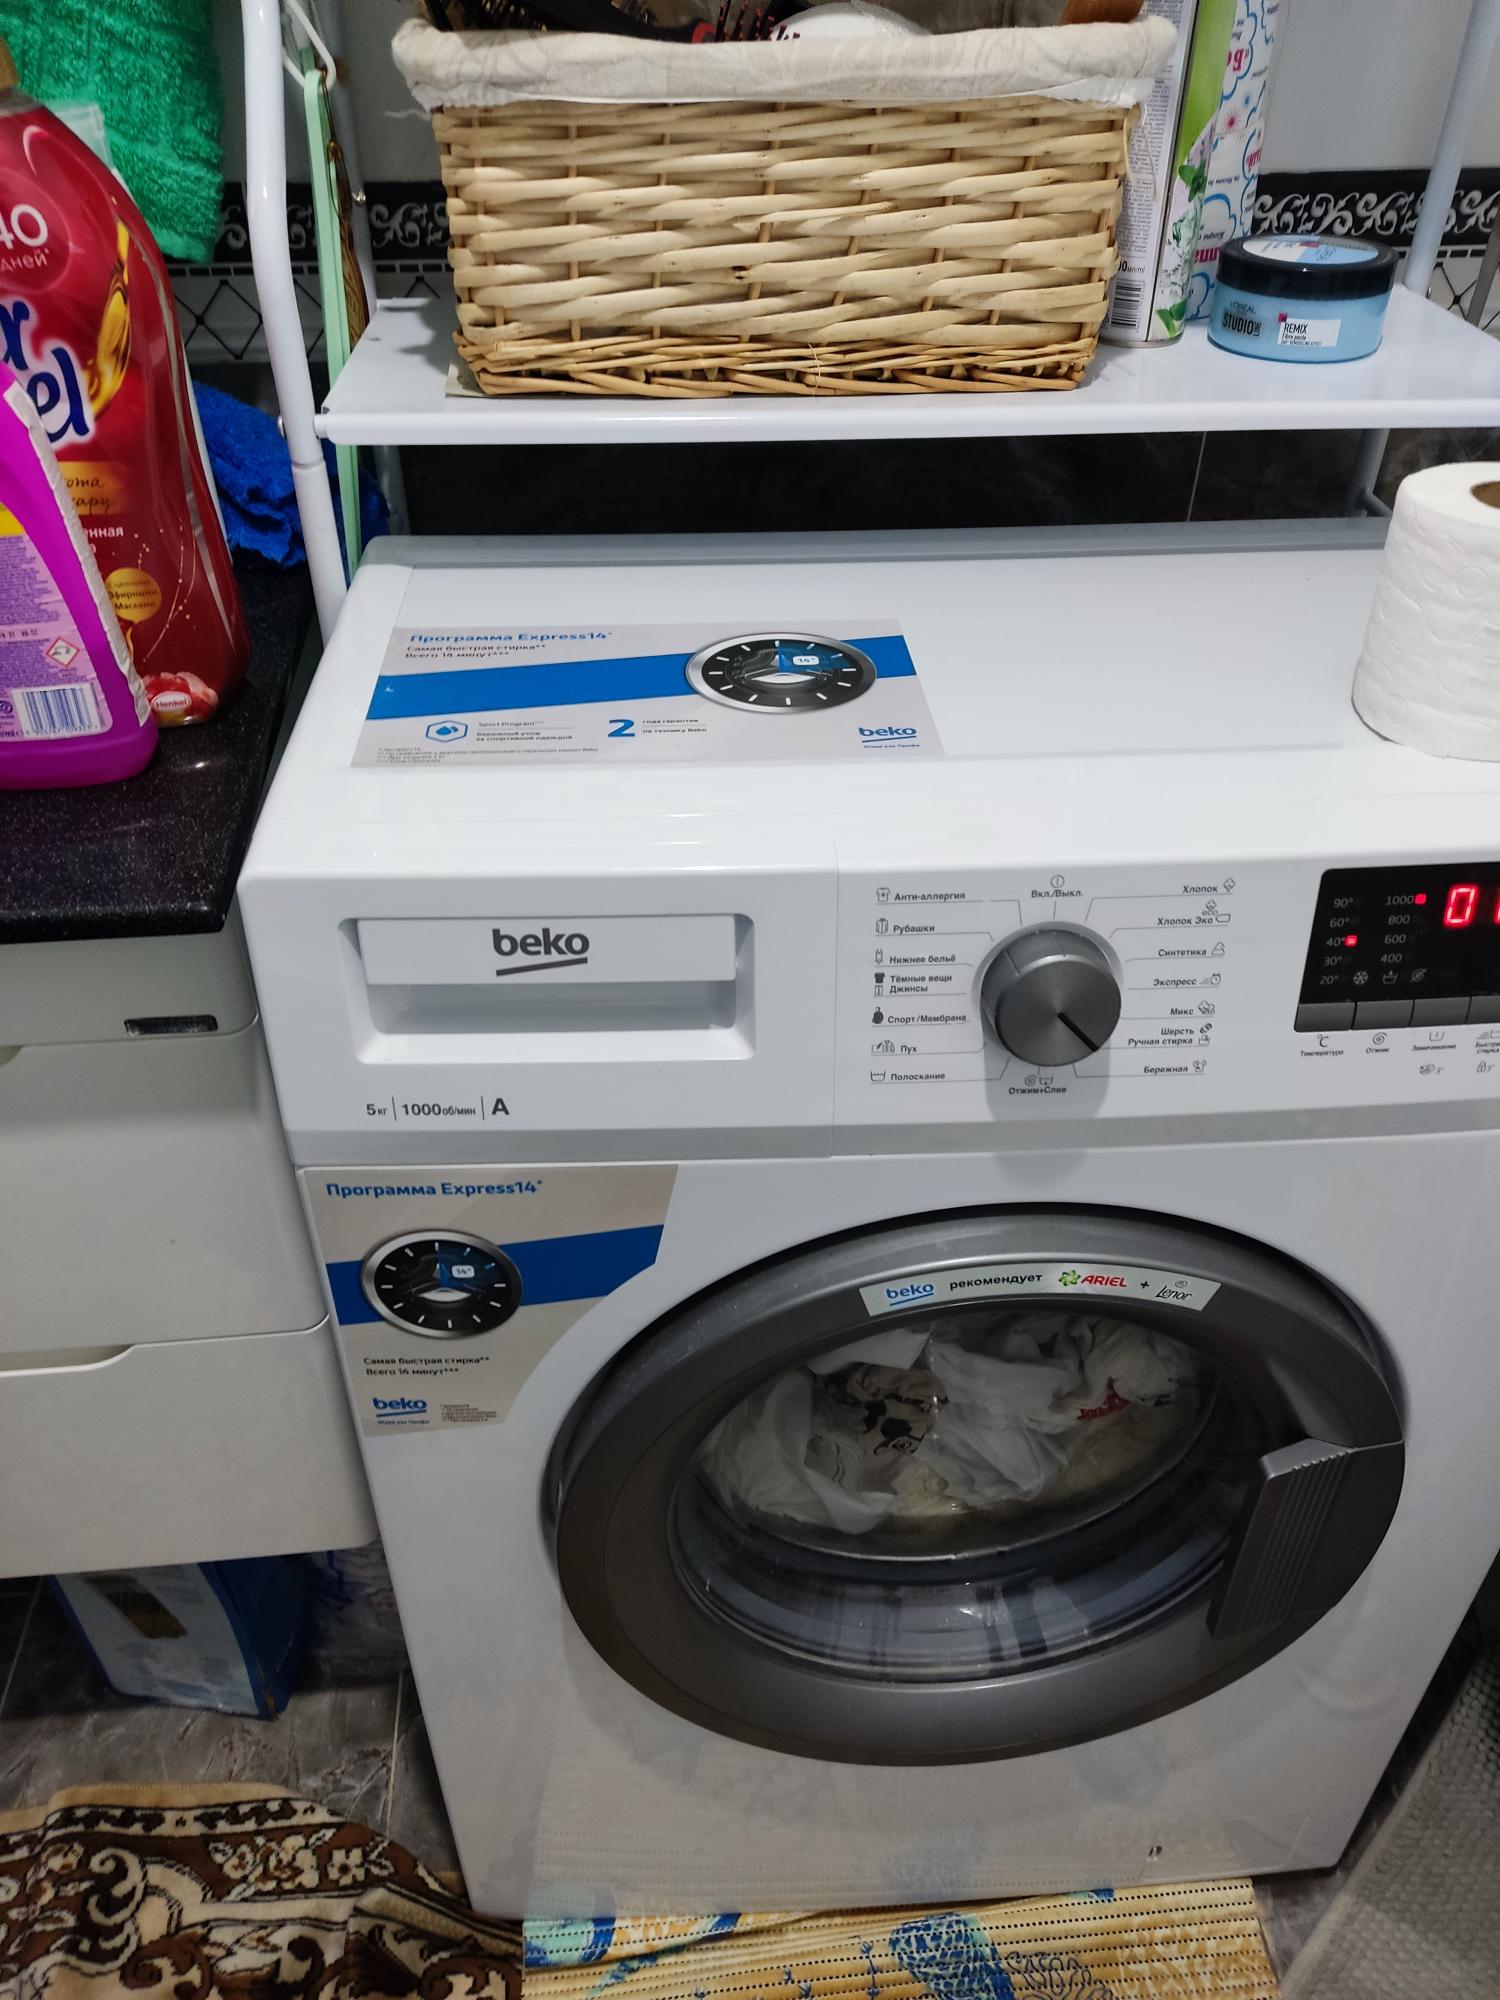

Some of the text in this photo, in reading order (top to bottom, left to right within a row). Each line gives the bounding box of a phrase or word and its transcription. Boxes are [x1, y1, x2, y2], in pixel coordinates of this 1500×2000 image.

[1223, 313, 1254, 335] STUDIO
[1283, 322, 1308, 334] REMIX
[410, 634, 513, 644] Программа
[155, 698, 187, 708] Henkel
[607, 719, 636, 737] 2
[859, 726, 917, 738] beko
[1183, 885, 1218, 894] Хлопок
[894, 890, 966, 902] Анти-аллергия
[1385, 895, 1414, 905] 1000
[1334, 898, 1353, 909] 90°
[1157, 916, 1213, 926] Хлопок Эко
[1329, 917, 1349, 928] 60°
[1388, 915, 1410, 925] 800
[893, 923, 935, 934] Рубашки
[492, 928, 591, 956] beko
[1384, 934, 1406, 944] 600
[889, 953, 956, 964] Нижнее бельё
[1158, 948, 1207, 958] Синтетика
[1380, 953, 1402, 963] 400
[1323, 955, 1343, 966] 30°
[890, 973, 953, 984] Тёмные вещи
[1153, 977, 1197, 988] Экспресс
[1319, 975, 1339, 985] 20°
[890, 984, 928, 995] Джинсы
[1170, 1008, 1194, 1017] Микс
[887, 1013, 967, 1025] Спорт/Мембрана
[1161, 1027, 1195, 1037] Шерсть
[1128, 1037, 1193, 1048] Ручная стирка
[900, 1043, 918, 1054] Пух
[1143, 1065, 1188, 1075] Бережная
[890, 1071, 946, 1081] Полоскание
[491, 1098, 510, 1116] A
[326, 1183, 436, 1199] Программа
[886, 1283, 934, 1299] beko
[949, 1273, 1043, 1291] рекомендует
[1080, 1275, 1127, 1288] ARIEL
[1155, 1286, 1192, 1301] Lenor
[363, 1356, 396, 1366] Самая
[398, 1356, 443, 1367] быстрая
[366, 1367, 396, 1376] Всего
[397, 1367, 409, 1376] 14
[372, 1397, 427, 1411] beko
